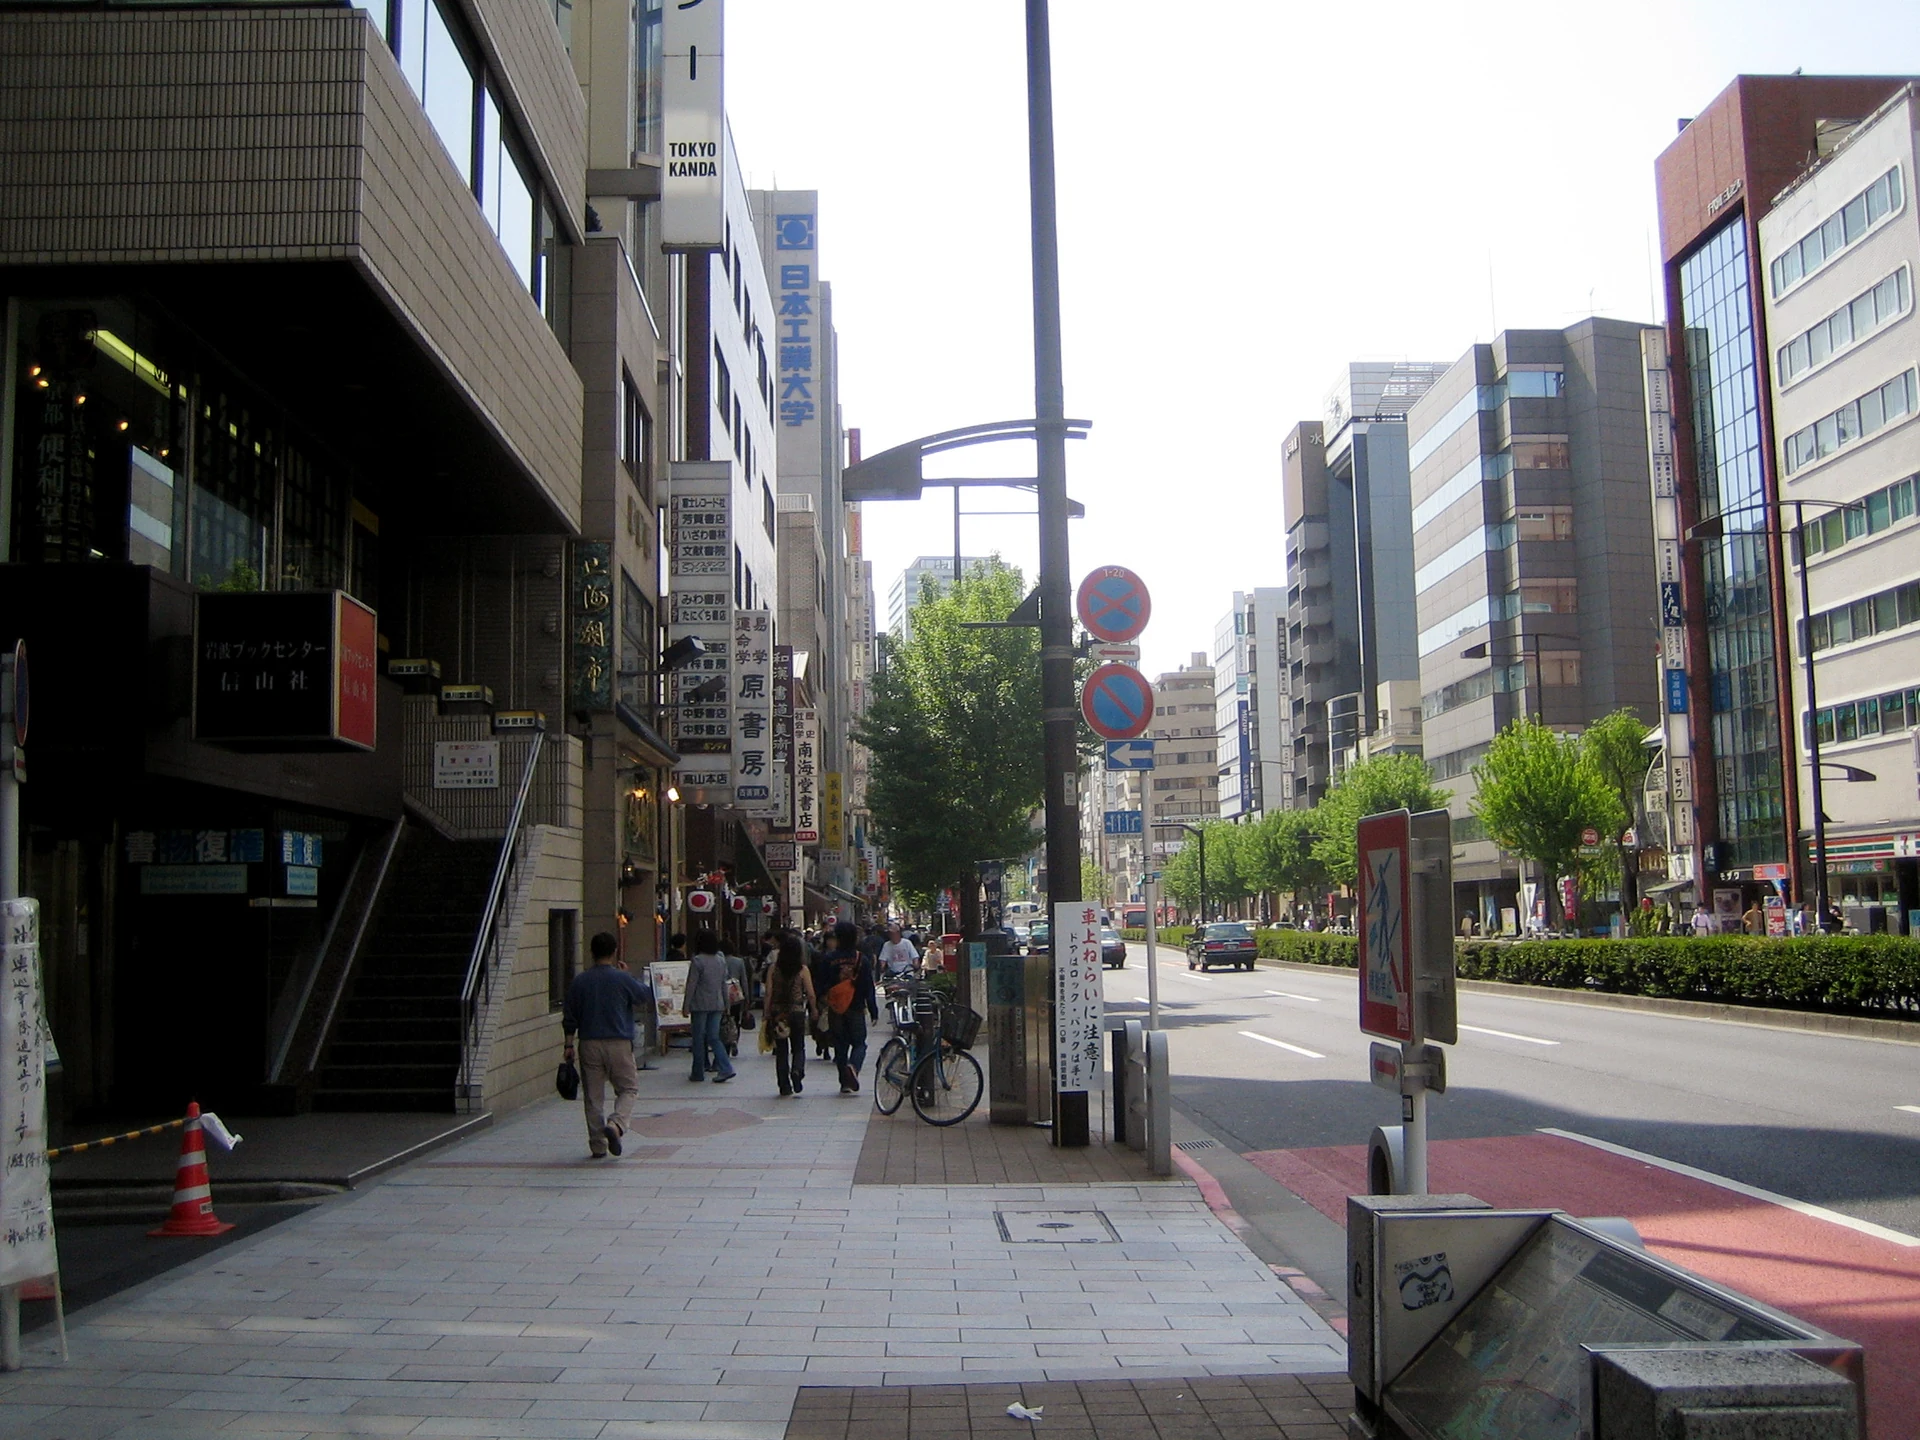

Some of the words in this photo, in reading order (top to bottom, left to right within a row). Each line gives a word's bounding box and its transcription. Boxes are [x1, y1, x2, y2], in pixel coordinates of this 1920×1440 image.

[669, 142, 716, 157] TOKYO
[669, 162, 717, 177] KANDA
[779, 264, 815, 427] 日本工業大学
[682, 498, 726, 508] 富士レコード社
[682, 513, 726, 525] 芳賀書店
[682, 530, 727, 541] いざわ書林
[682, 545, 726, 557] 文献書院
[681, 593, 726, 606] みわ書房
[682, 609, 727, 622] たにぐち書店
[735, 616, 751, 666] 運命学
[753, 616, 768, 666] 易学
[205, 640, 327, 660] 岩波ブックセンター
[220, 669, 309, 692] 信山社
[682, 708, 727, 719] 中野書店
[682, 724, 727, 736] 中野書店
[738, 673, 767, 777] 原書房
[798, 741, 816, 829] 南海堂書店
